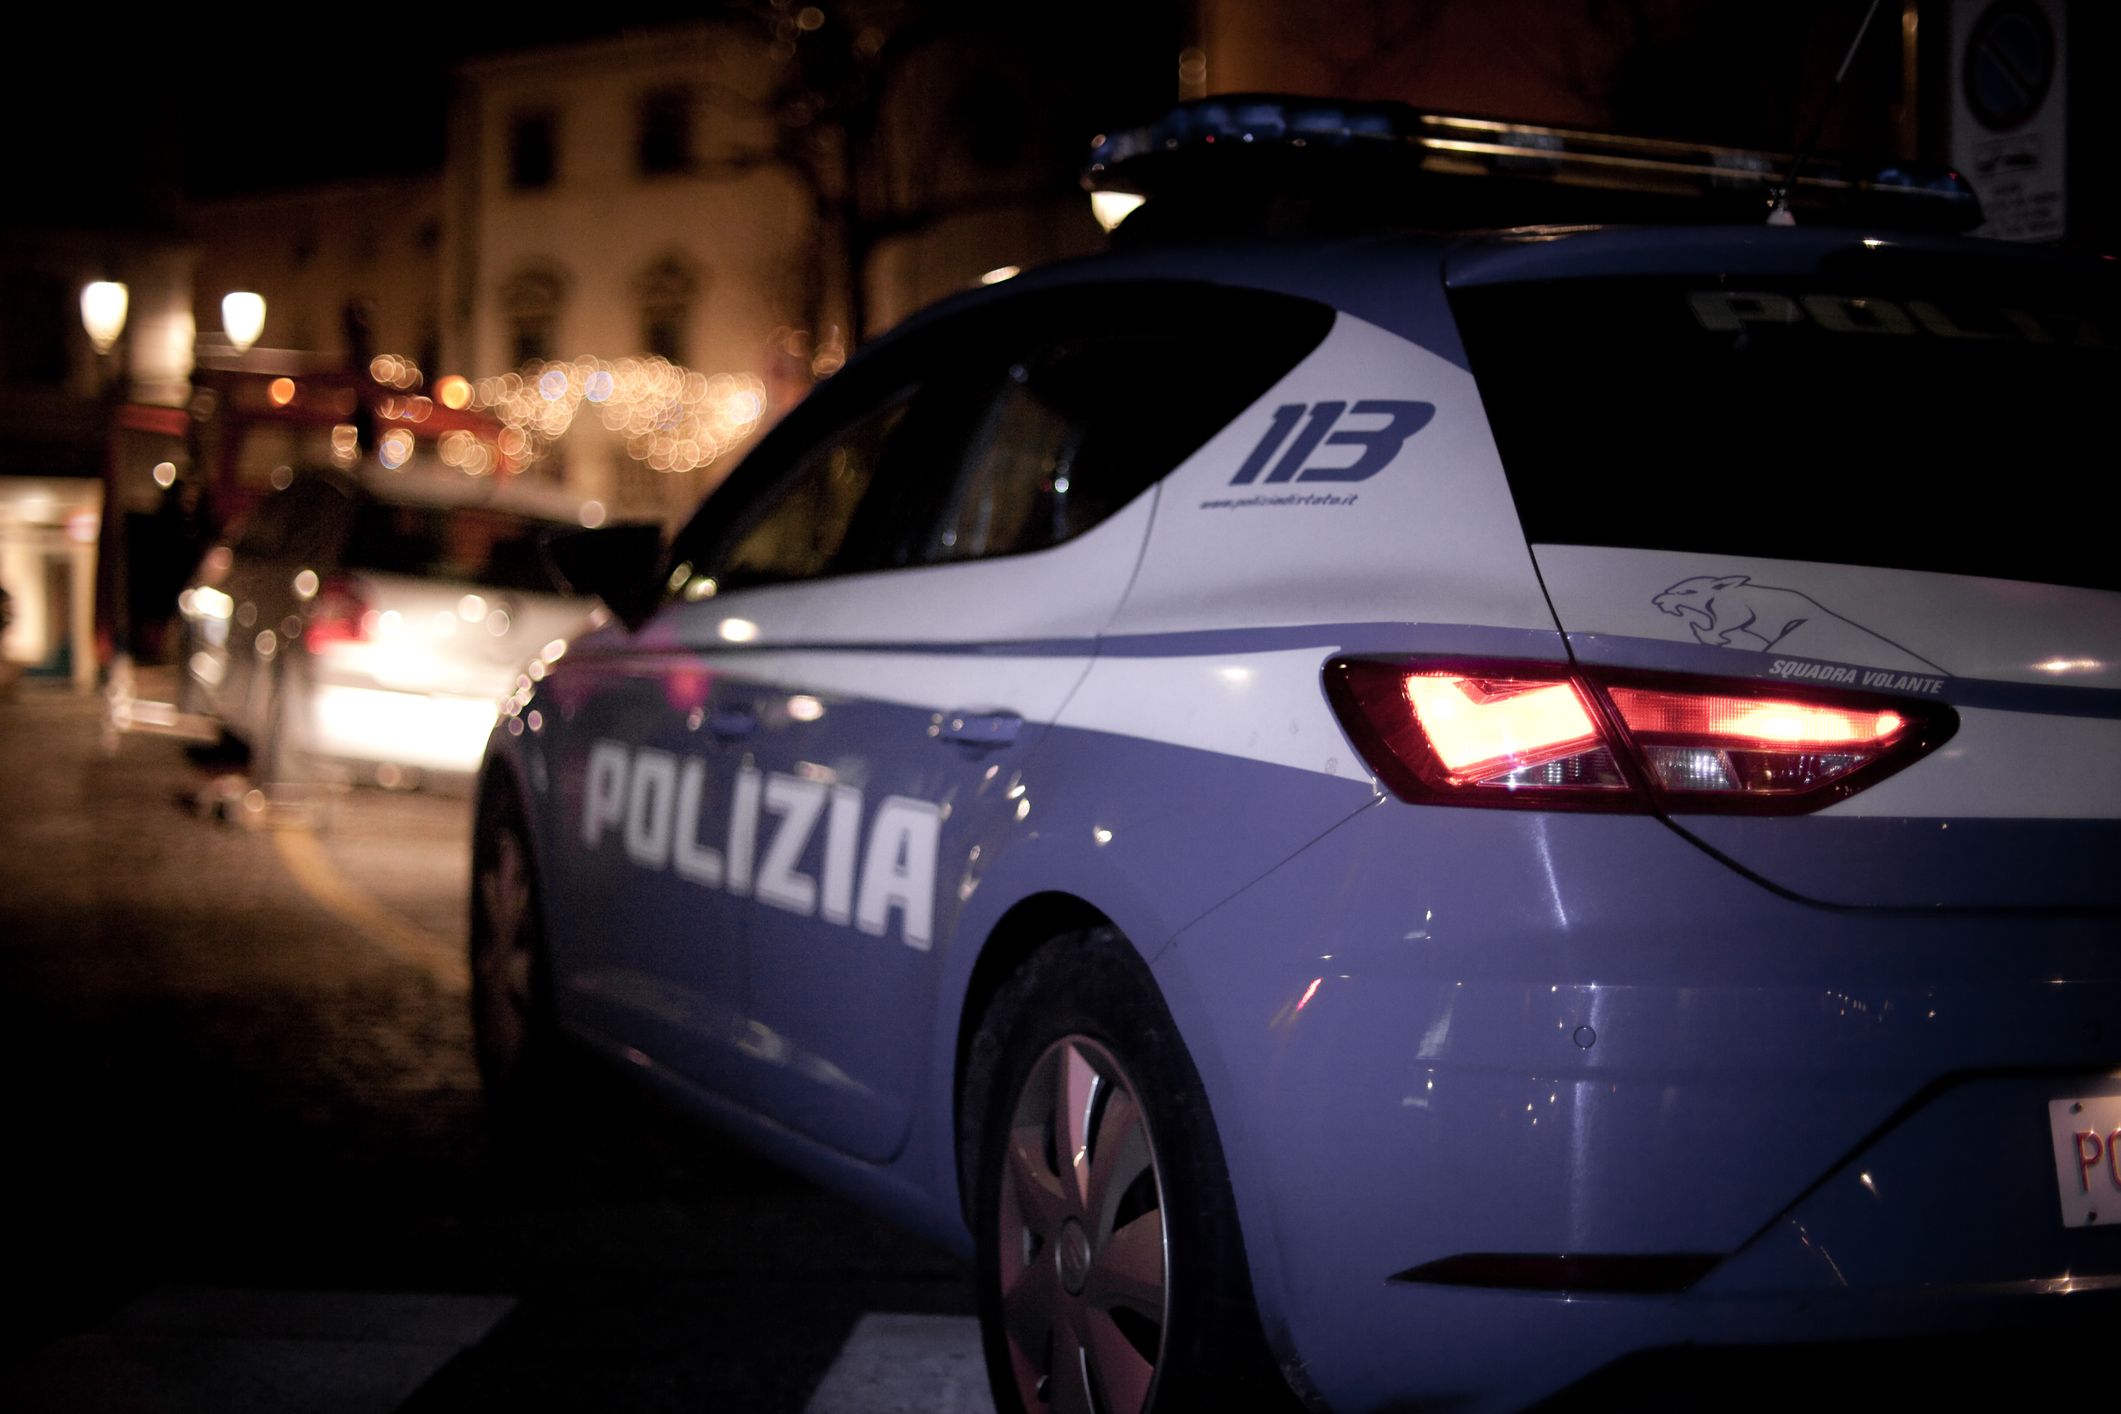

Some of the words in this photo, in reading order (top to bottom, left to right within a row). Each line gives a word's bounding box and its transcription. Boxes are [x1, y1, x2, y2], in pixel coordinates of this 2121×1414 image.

[1229, 400, 1436, 486] 113
[1769, 659, 1857, 683] SQUADRA
[1861, 671, 1944, 694] VOLANTE
[583, 740, 939, 951] POLIZIA
